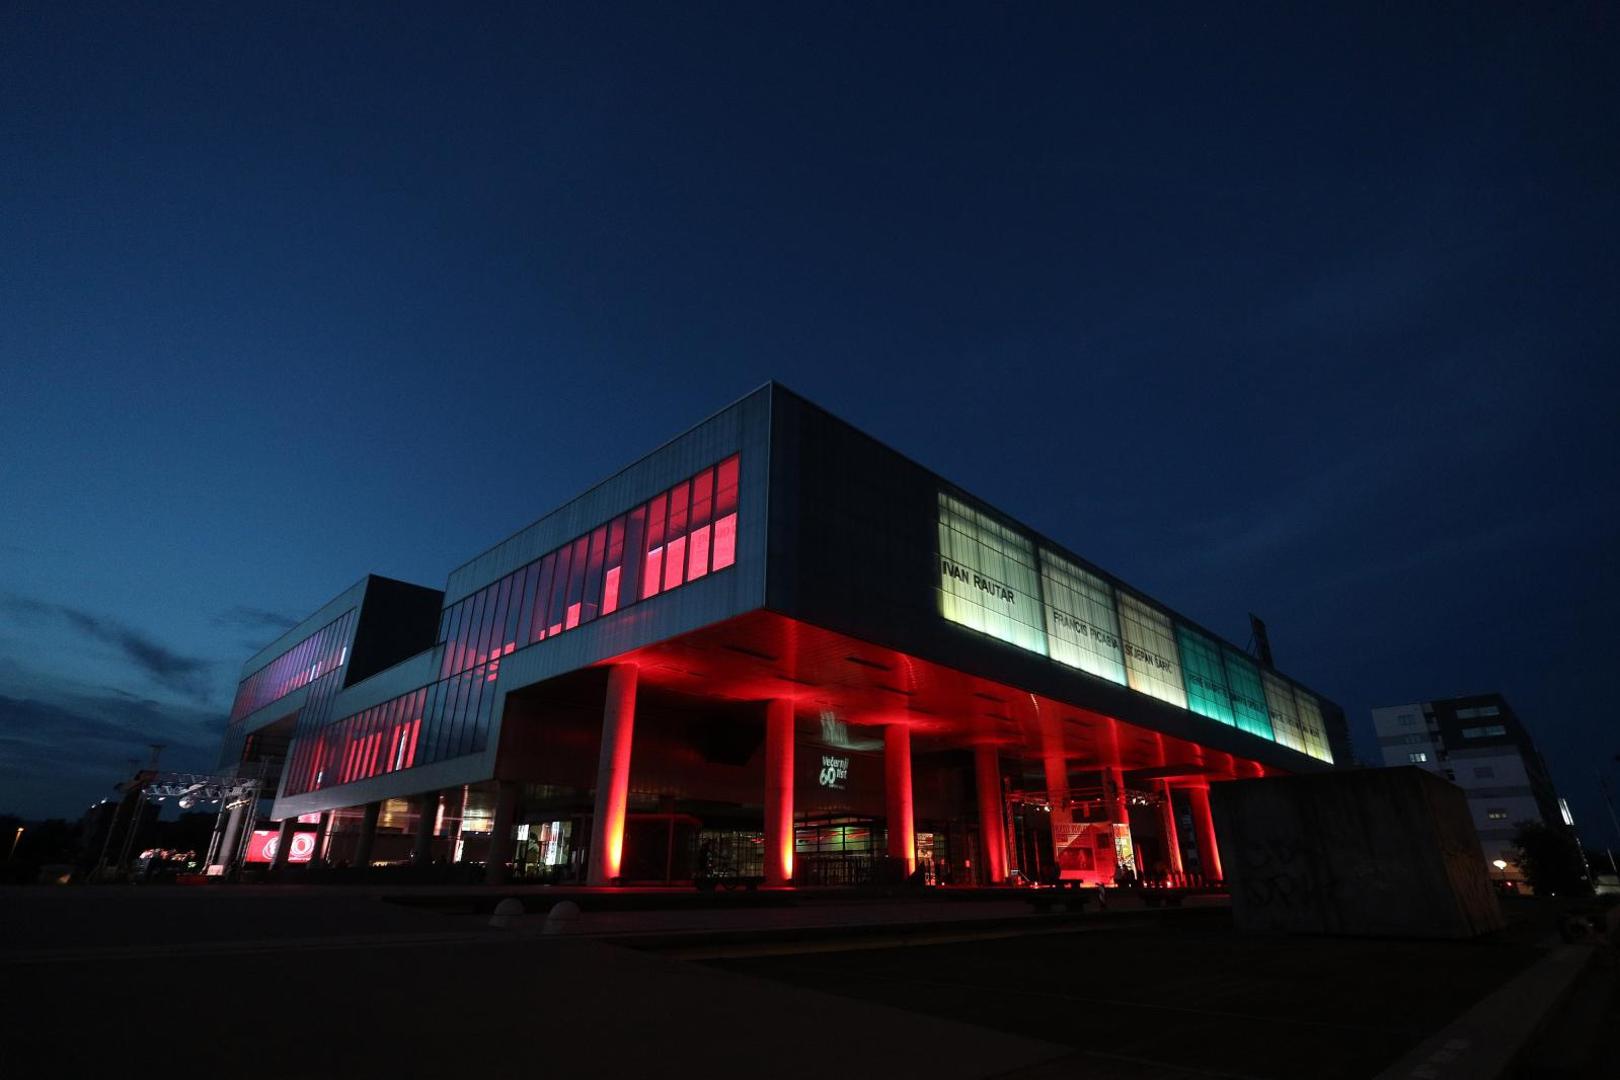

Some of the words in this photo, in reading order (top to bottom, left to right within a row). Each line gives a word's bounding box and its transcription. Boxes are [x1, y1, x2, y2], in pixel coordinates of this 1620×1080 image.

[942, 560, 969, 584] IVAN
[973, 574, 1015, 605] RAUTAR
[819, 767, 837, 786] 60
